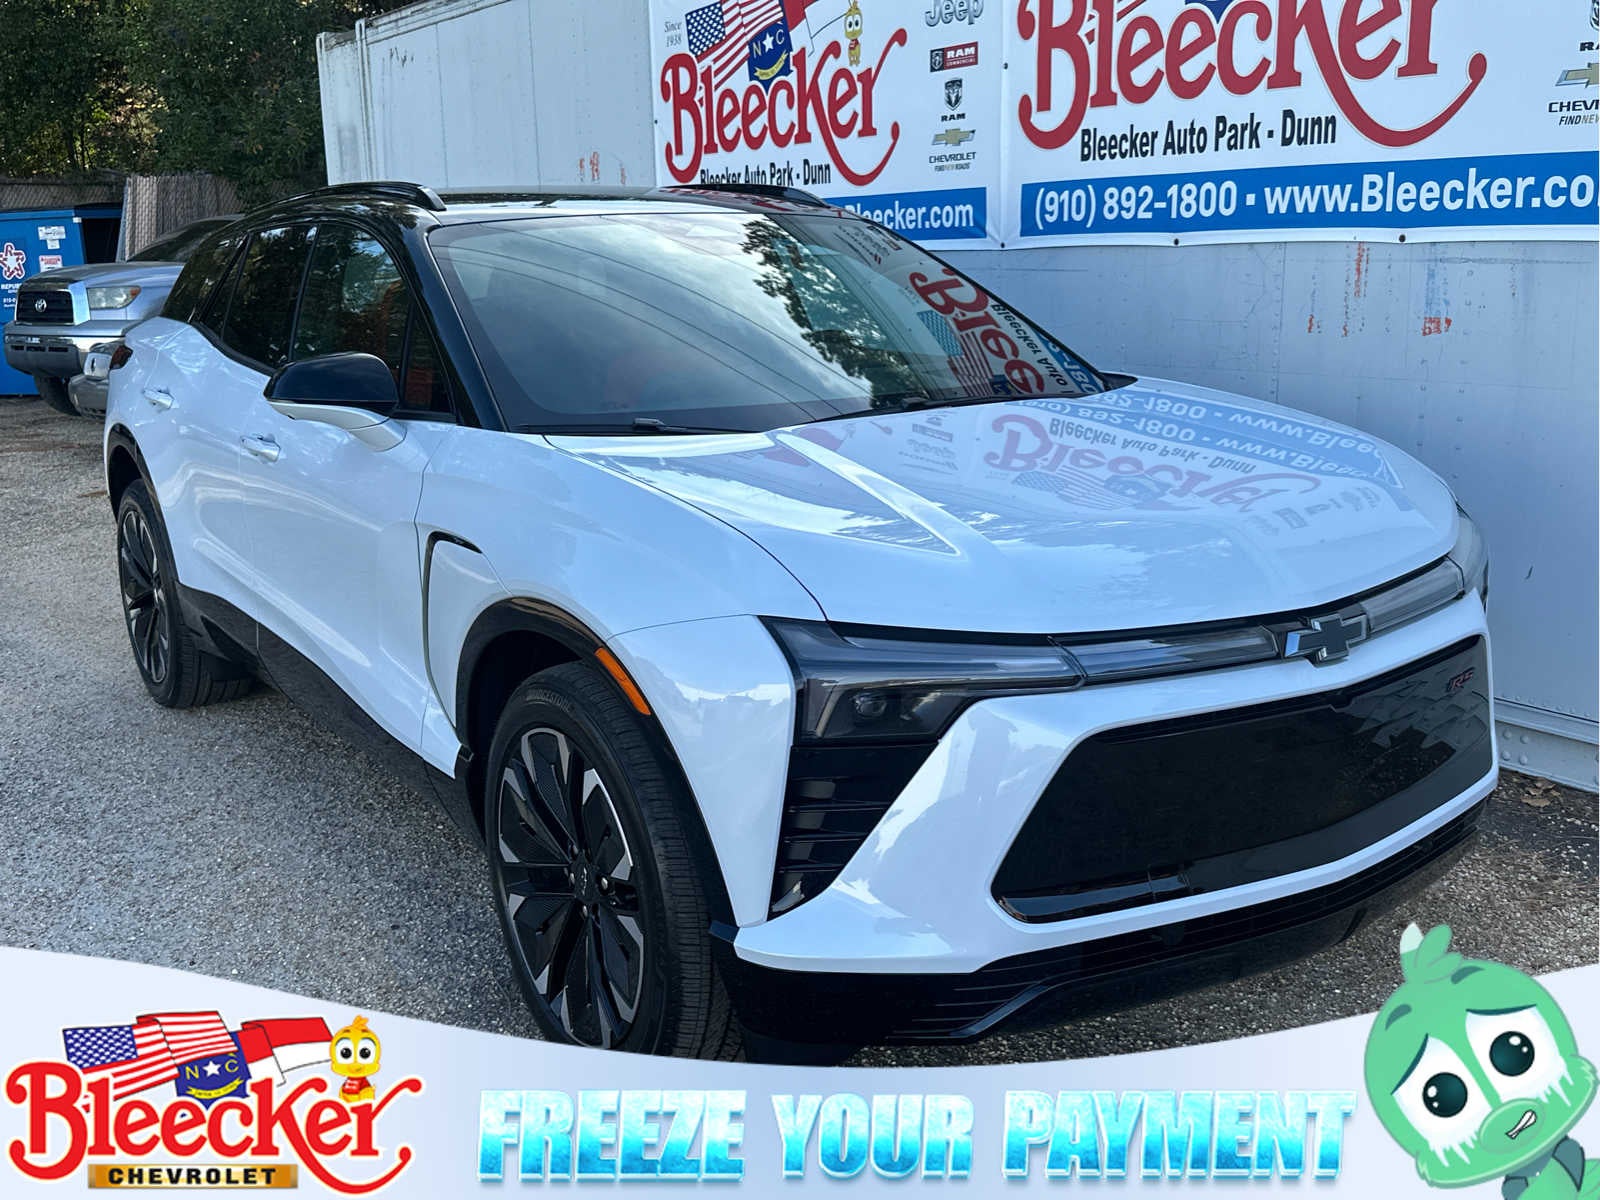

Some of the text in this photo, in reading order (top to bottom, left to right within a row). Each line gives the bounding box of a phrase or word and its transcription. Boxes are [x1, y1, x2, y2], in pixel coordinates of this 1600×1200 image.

[925, 0, 985, 27] Jeep
[946, 46, 976, 59] RAM
[1017, 0, 1487, 149] Bleecker
[660, 27, 907, 187] Bleecker
[941, 113, 966, 122] RAM
[1080, 109, 1337, 162] Bleecker Auto Park Dunn
[928, 151, 977, 164] CHEVROLET
[744, 164, 767, 185] Auto
[769, 160, 794, 187] Park
[802, 158, 832, 185] Dunn
[1035, 167, 1600, 230] (910) 892-1800 www.Bleecker.co
